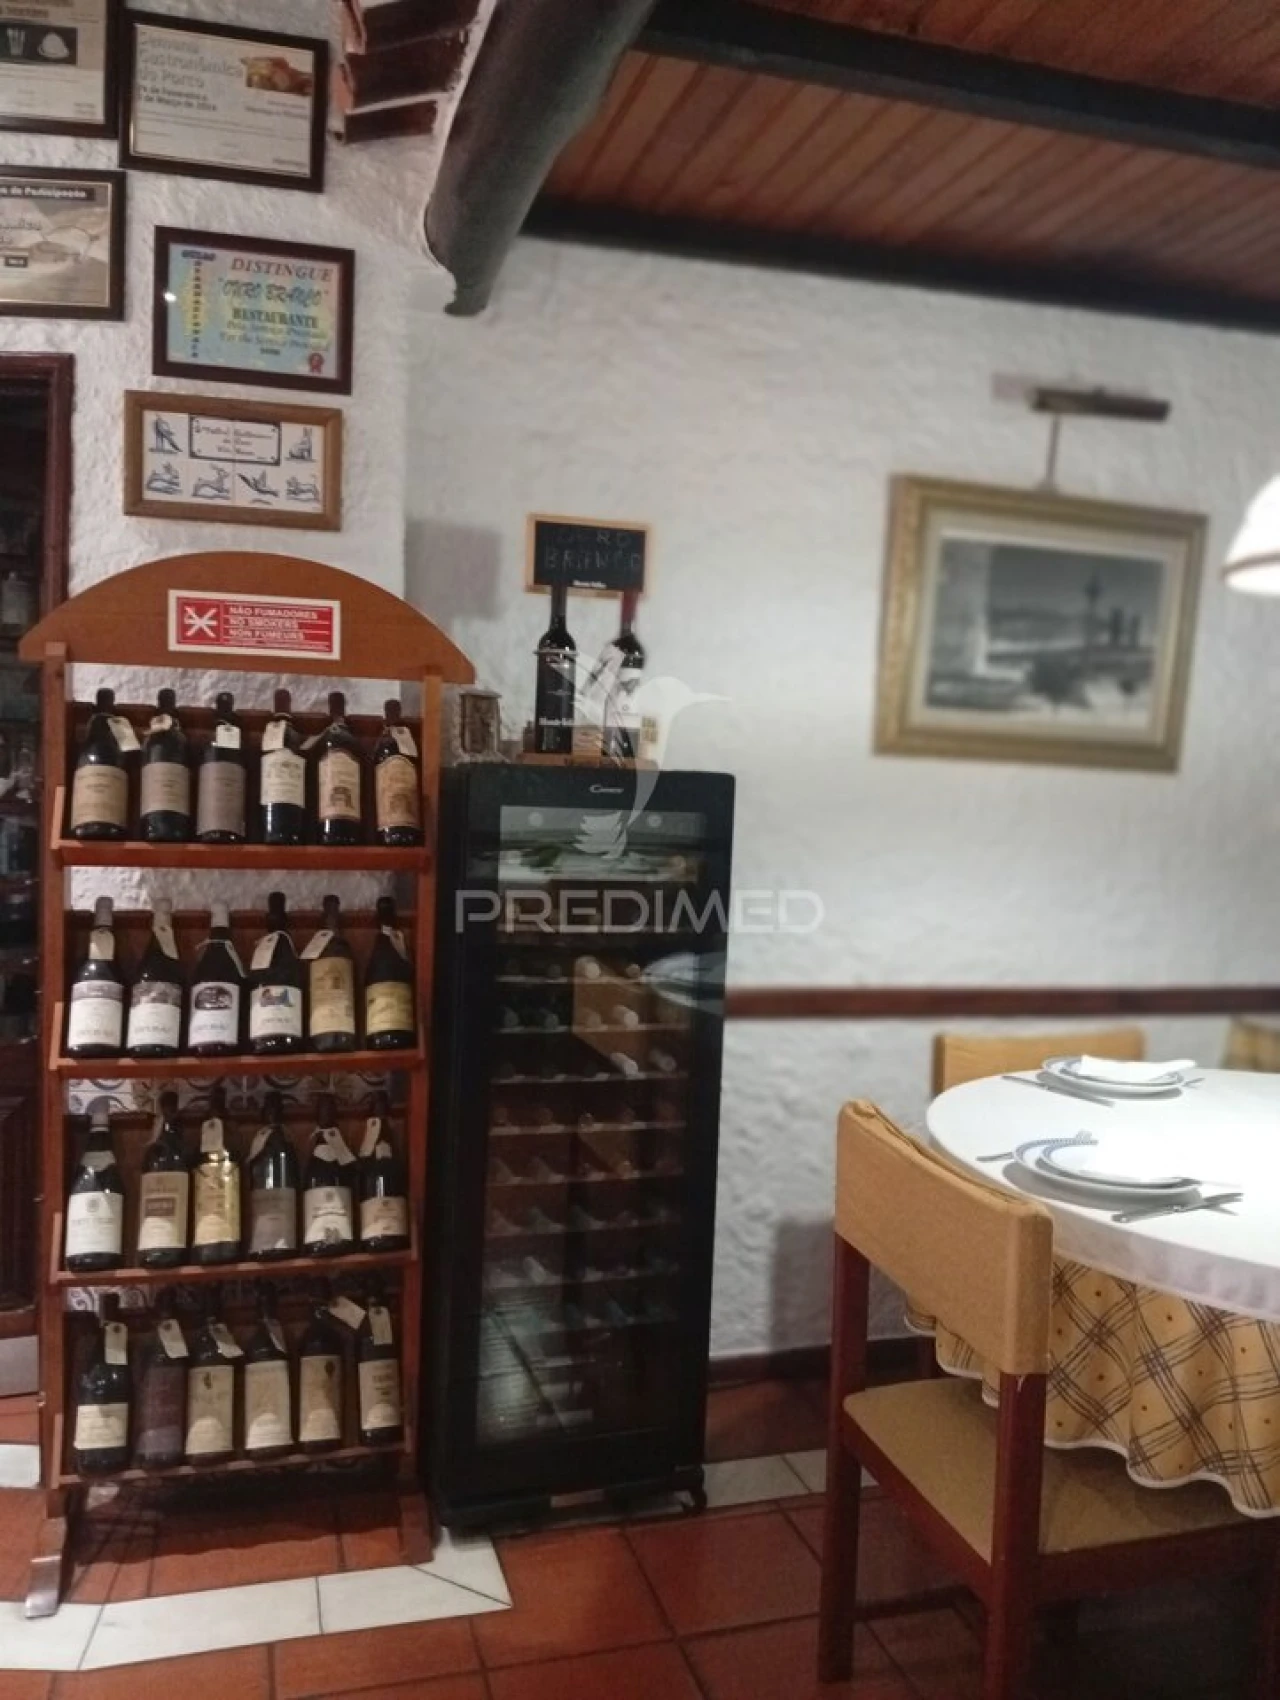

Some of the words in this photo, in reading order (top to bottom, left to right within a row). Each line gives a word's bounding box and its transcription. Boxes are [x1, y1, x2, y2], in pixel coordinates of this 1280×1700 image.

[231, 258, 334, 282] DISTINGUE
[232, 308, 319, 329] RESTAURANTE
[229, 605, 253, 615] NÃO
[254, 608, 318, 620] FUMADORES
[229, 617, 243, 626] NO
[247, 618, 299, 630] SMOKERS
[229, 629, 251, 638] NON
[255, 630, 305, 641] FUMEURS
